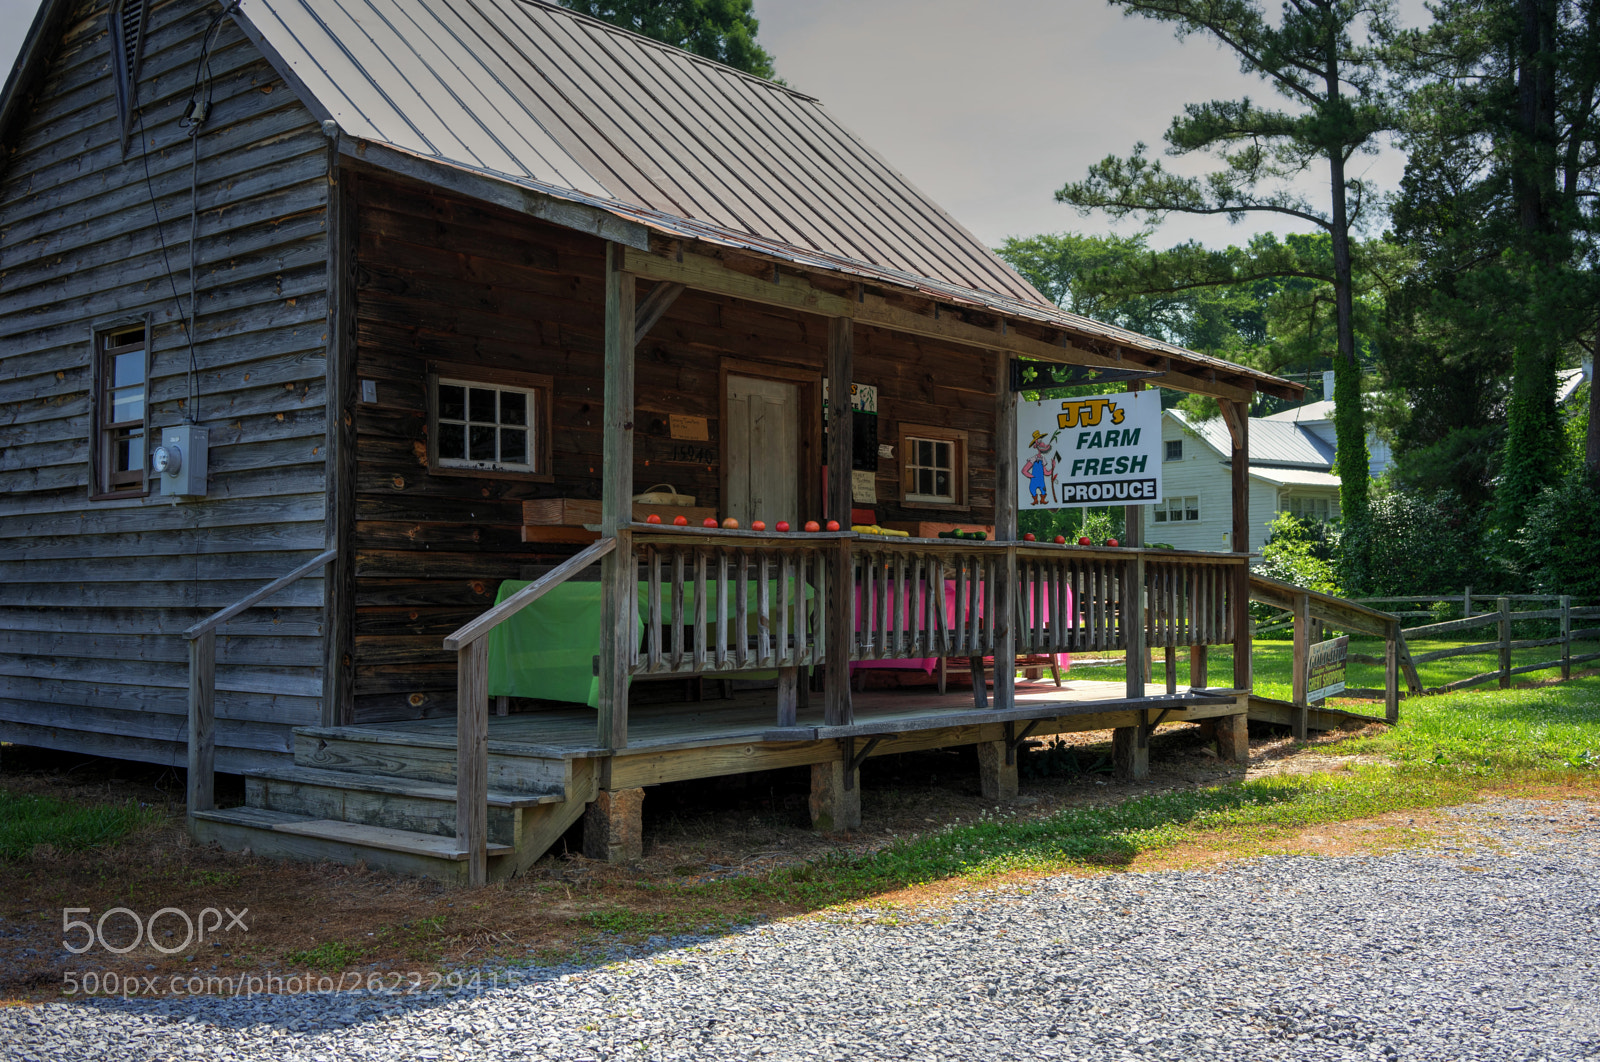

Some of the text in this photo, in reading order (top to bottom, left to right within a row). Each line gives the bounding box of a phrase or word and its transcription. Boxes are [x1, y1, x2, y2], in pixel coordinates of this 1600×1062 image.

[1057, 399, 1125, 429] JJ's
[1076, 428, 1141, 450] FARM
[1070, 455, 1148, 477] FRESH
[1063, 481, 1155, 501] PRODUCE
